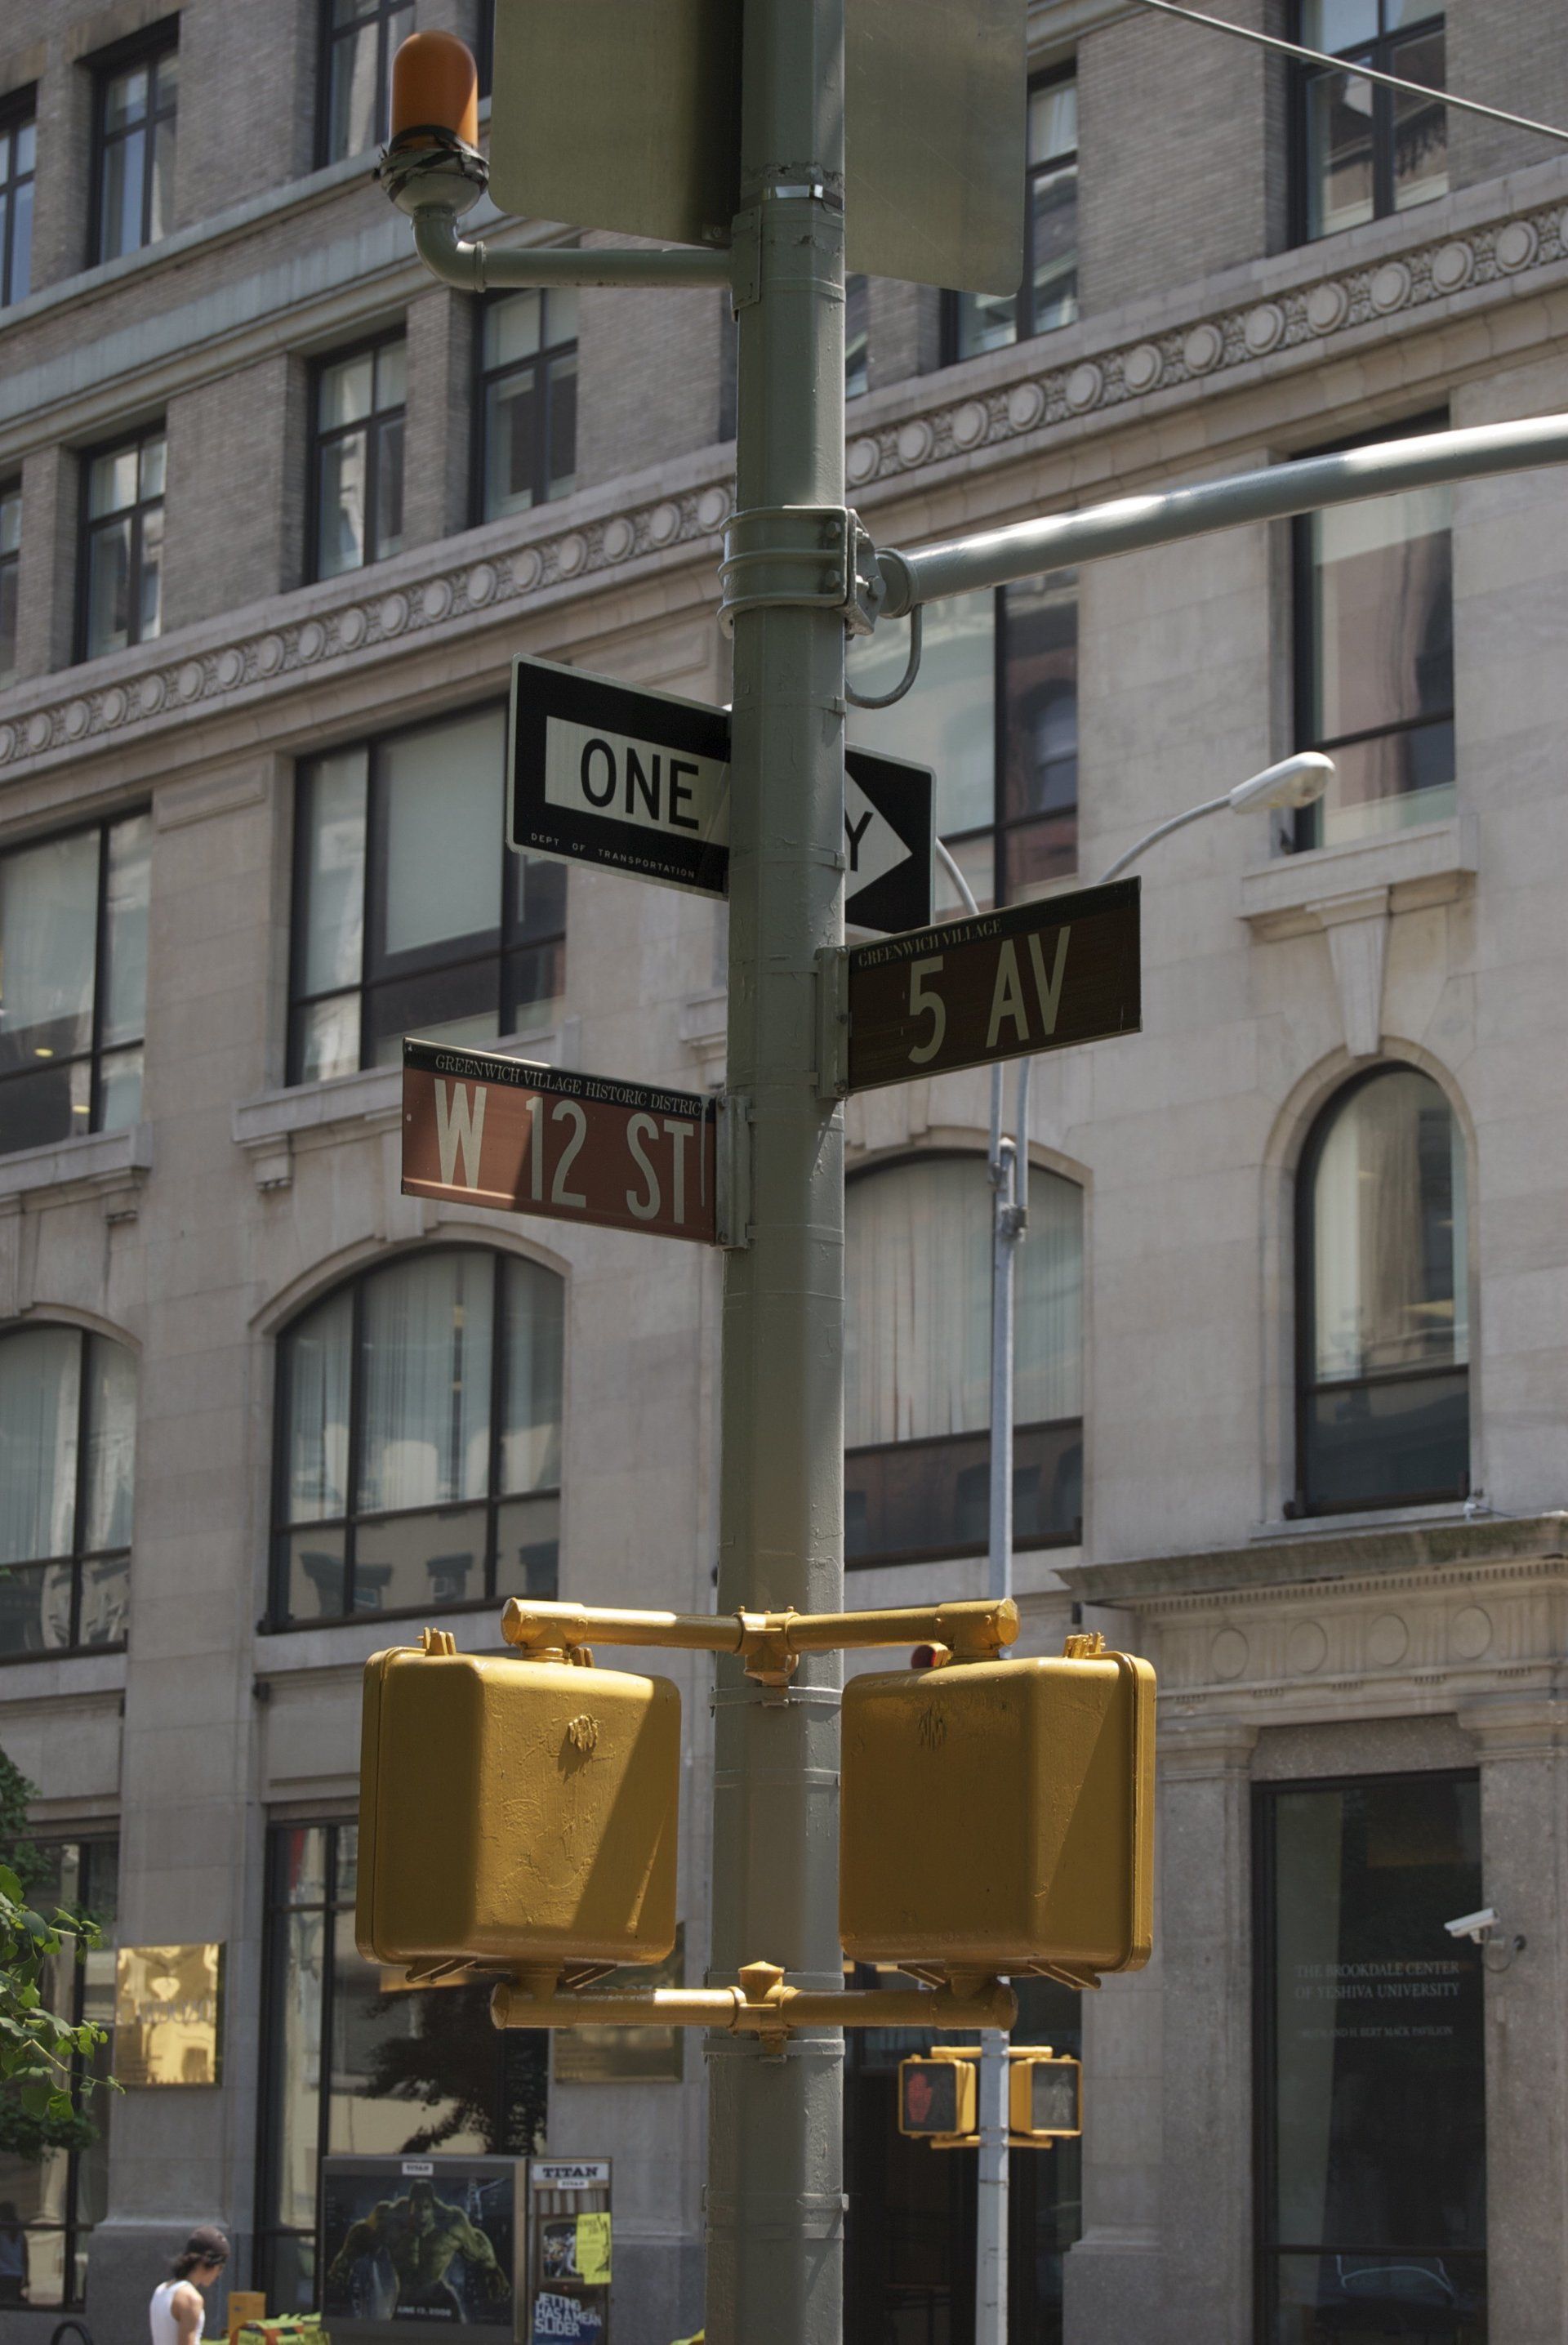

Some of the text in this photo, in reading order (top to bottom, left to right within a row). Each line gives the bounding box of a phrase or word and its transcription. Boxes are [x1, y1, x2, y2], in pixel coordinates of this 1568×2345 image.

[580, 738, 700, 831] ONE
[531, 831, 695, 879] DEPT OF TRANSPORTATION
[858, 918, 1002, 967] GREENWICH VILLAGE
[907, 925, 1071, 1064] 5 AV
[435, 1054, 521, 1083] GREENWICH
[523, 1069, 582, 1095] VILLAGE
[586, 1081, 648, 1107] HISTORIC
[434, 1078, 694, 1225] W 12 ST
[1295, 1960, 1460, 1978] THE BROOKDALE CENTER
[1315, 1985, 1373, 1999] YESHIVA
[1377, 1982, 1460, 1998] UNIVERSITY
[542, 2166, 599, 2178] TITAN
[534, 2317, 581, 2338] SLIDER
